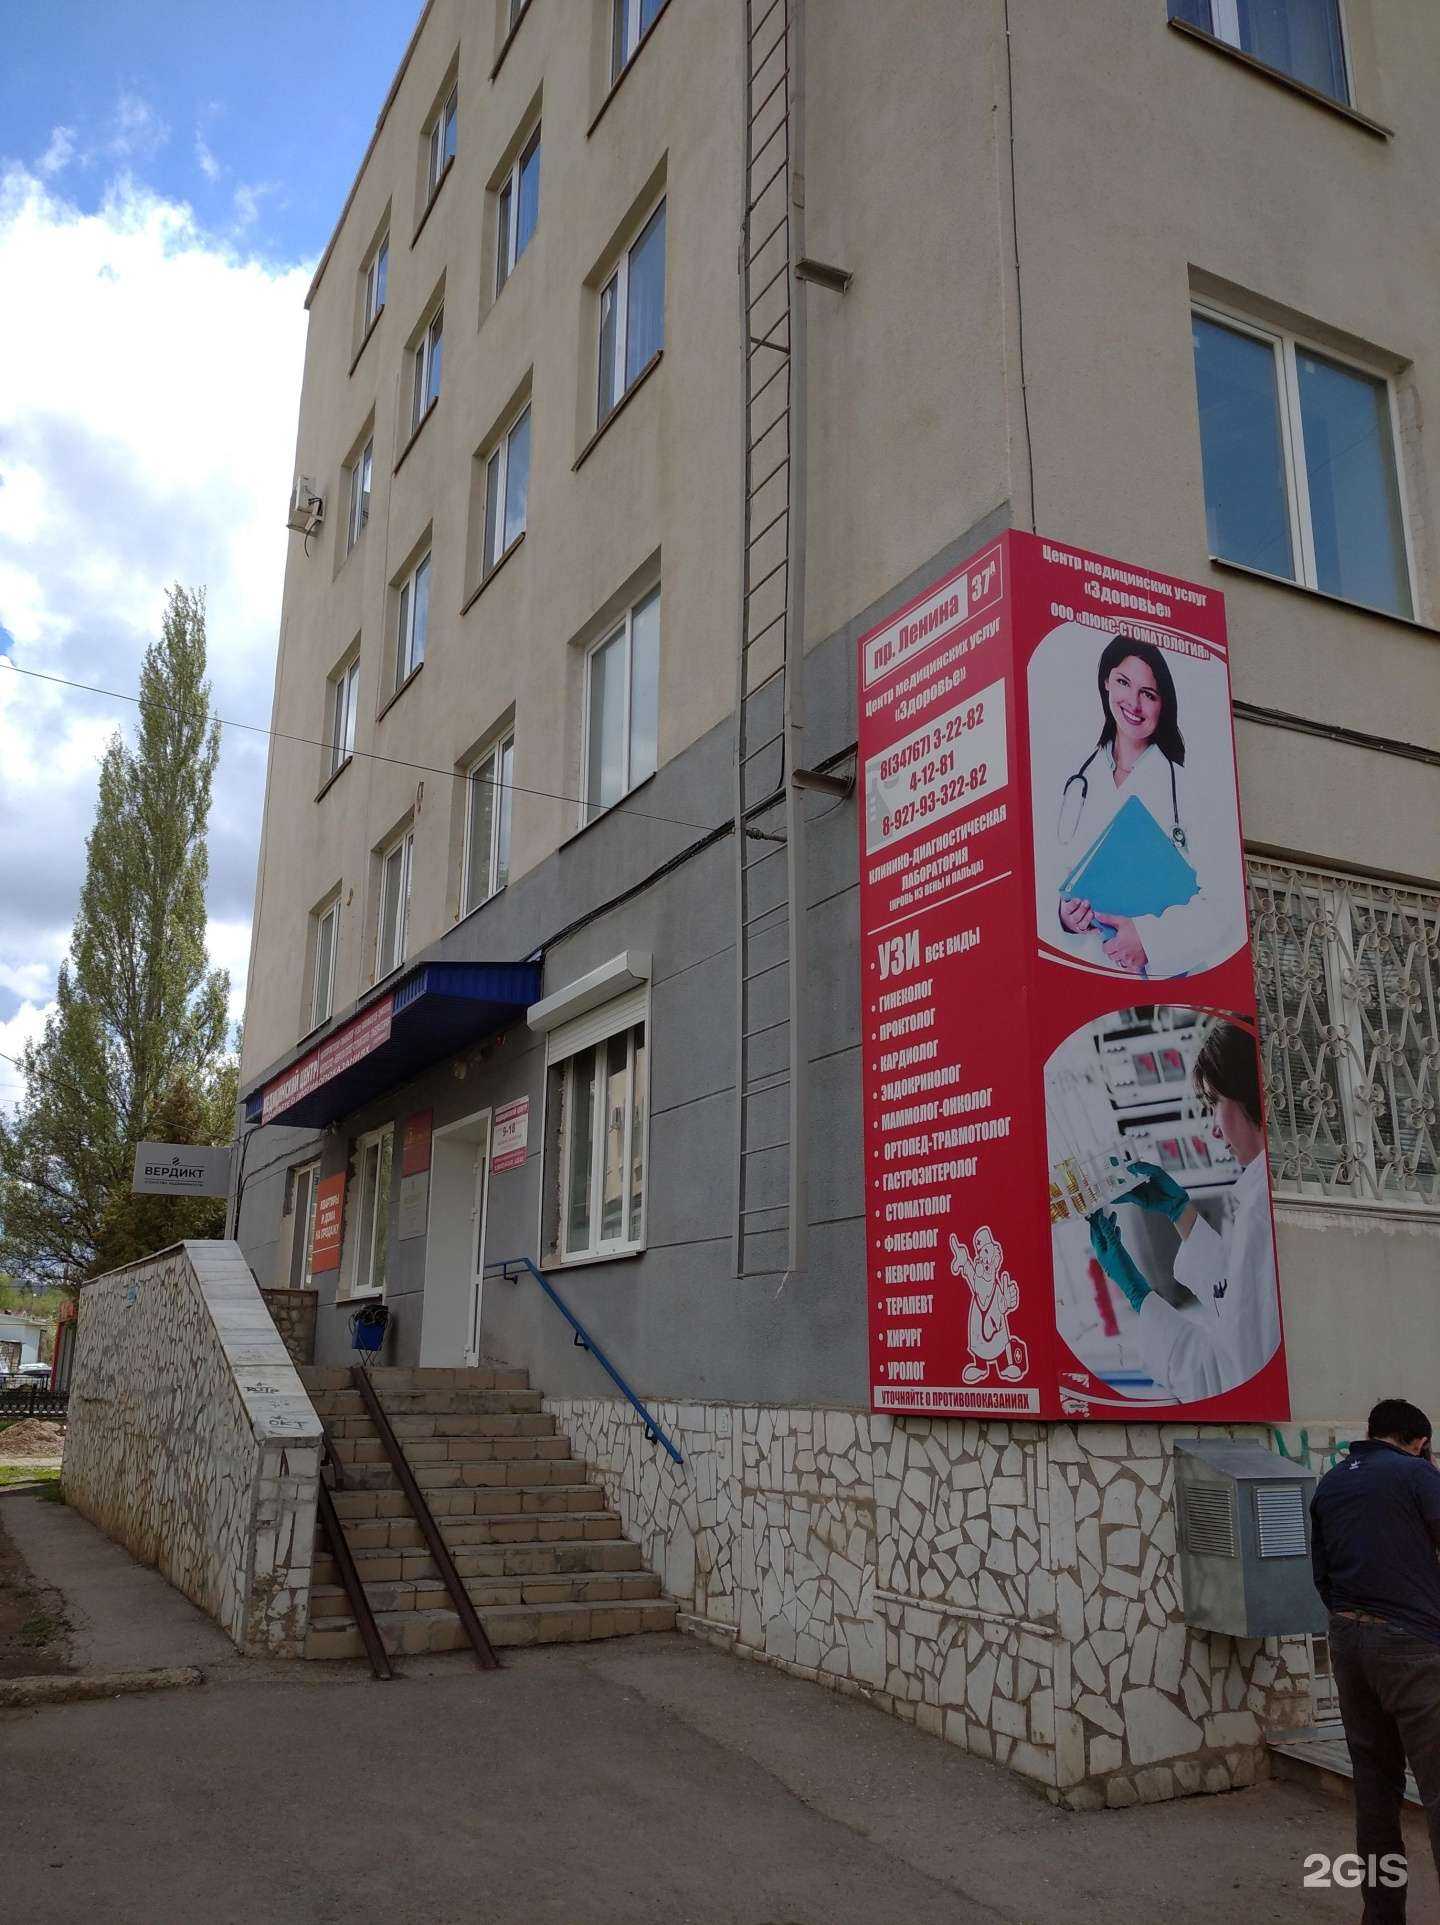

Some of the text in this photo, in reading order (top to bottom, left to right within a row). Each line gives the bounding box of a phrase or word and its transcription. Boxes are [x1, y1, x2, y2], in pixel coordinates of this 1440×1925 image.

[1042, 544, 1207, 607] Центр медицинских услуг
[1084, 580, 1172, 618] «Здоровье»
[874, 641, 896, 669] пр.
[898, 594, 959, 653] Ленина
[1051, 602, 1211, 659] ООО «ЛЮКС-СТОМАТОЛОГИЯ»
[865, 616, 1001, 718] Центр медицинских услуг
[895, 666, 967, 722] «Здоровье»
[880, 702, 984, 781] 8(34767) 3-22-82
[909, 750, 954, 793] 4-12-81
[881, 763, 987, 837] 8-927-93-322-82
[869, 804, 1007, 885] КЛИНИКО-ДИАГНОСТИЧЕСКАЯ
[889, 859, 984, 912] (КРОВЬ ИЗ ВЕНЫ И ПАЛЬЦА)
[901, 846, 969, 891] ЛАБОРАТОРИЯ
[877, 926, 981, 981] УЗИ ВСЕ ВИДЫ
[879, 978, 933, 1013] ГИНЕКОЛОГ
[879, 1008, 936, 1041] ПРОКТОЛОГ
[880, 1039, 939, 1072] КАРДИОЛОГ
[881, 1064, 961, 1102] ЭНДОКРИНОЛОГ
[881, 1088, 993, 1132] МАММОЛОГ-ОНКОЛОГ
[144, 1166, 205, 1178] ВЕРДИКТ
[882, 1156, 978, 1192] ГАСТРОЭНТЕРОЛОГ
[885, 1194, 952, 1222] СТОМАТОЛОГ
[884, 1228, 939, 1253] ФЛЕБОЛОГ
[885, 1261, 936, 1285] НЕВРОЛОГ
[885, 1294, 934, 1316] ТЕРАПЕВТ
[886, 1328, 923, 1348] ХИРУРГ
[887, 1361, 925, 1380] УРОЛОГ
[881, 1388, 1030, 1410] УТОЧНЯЙТЕ О ПРОТИВОПОКАЗАНИЯХ
